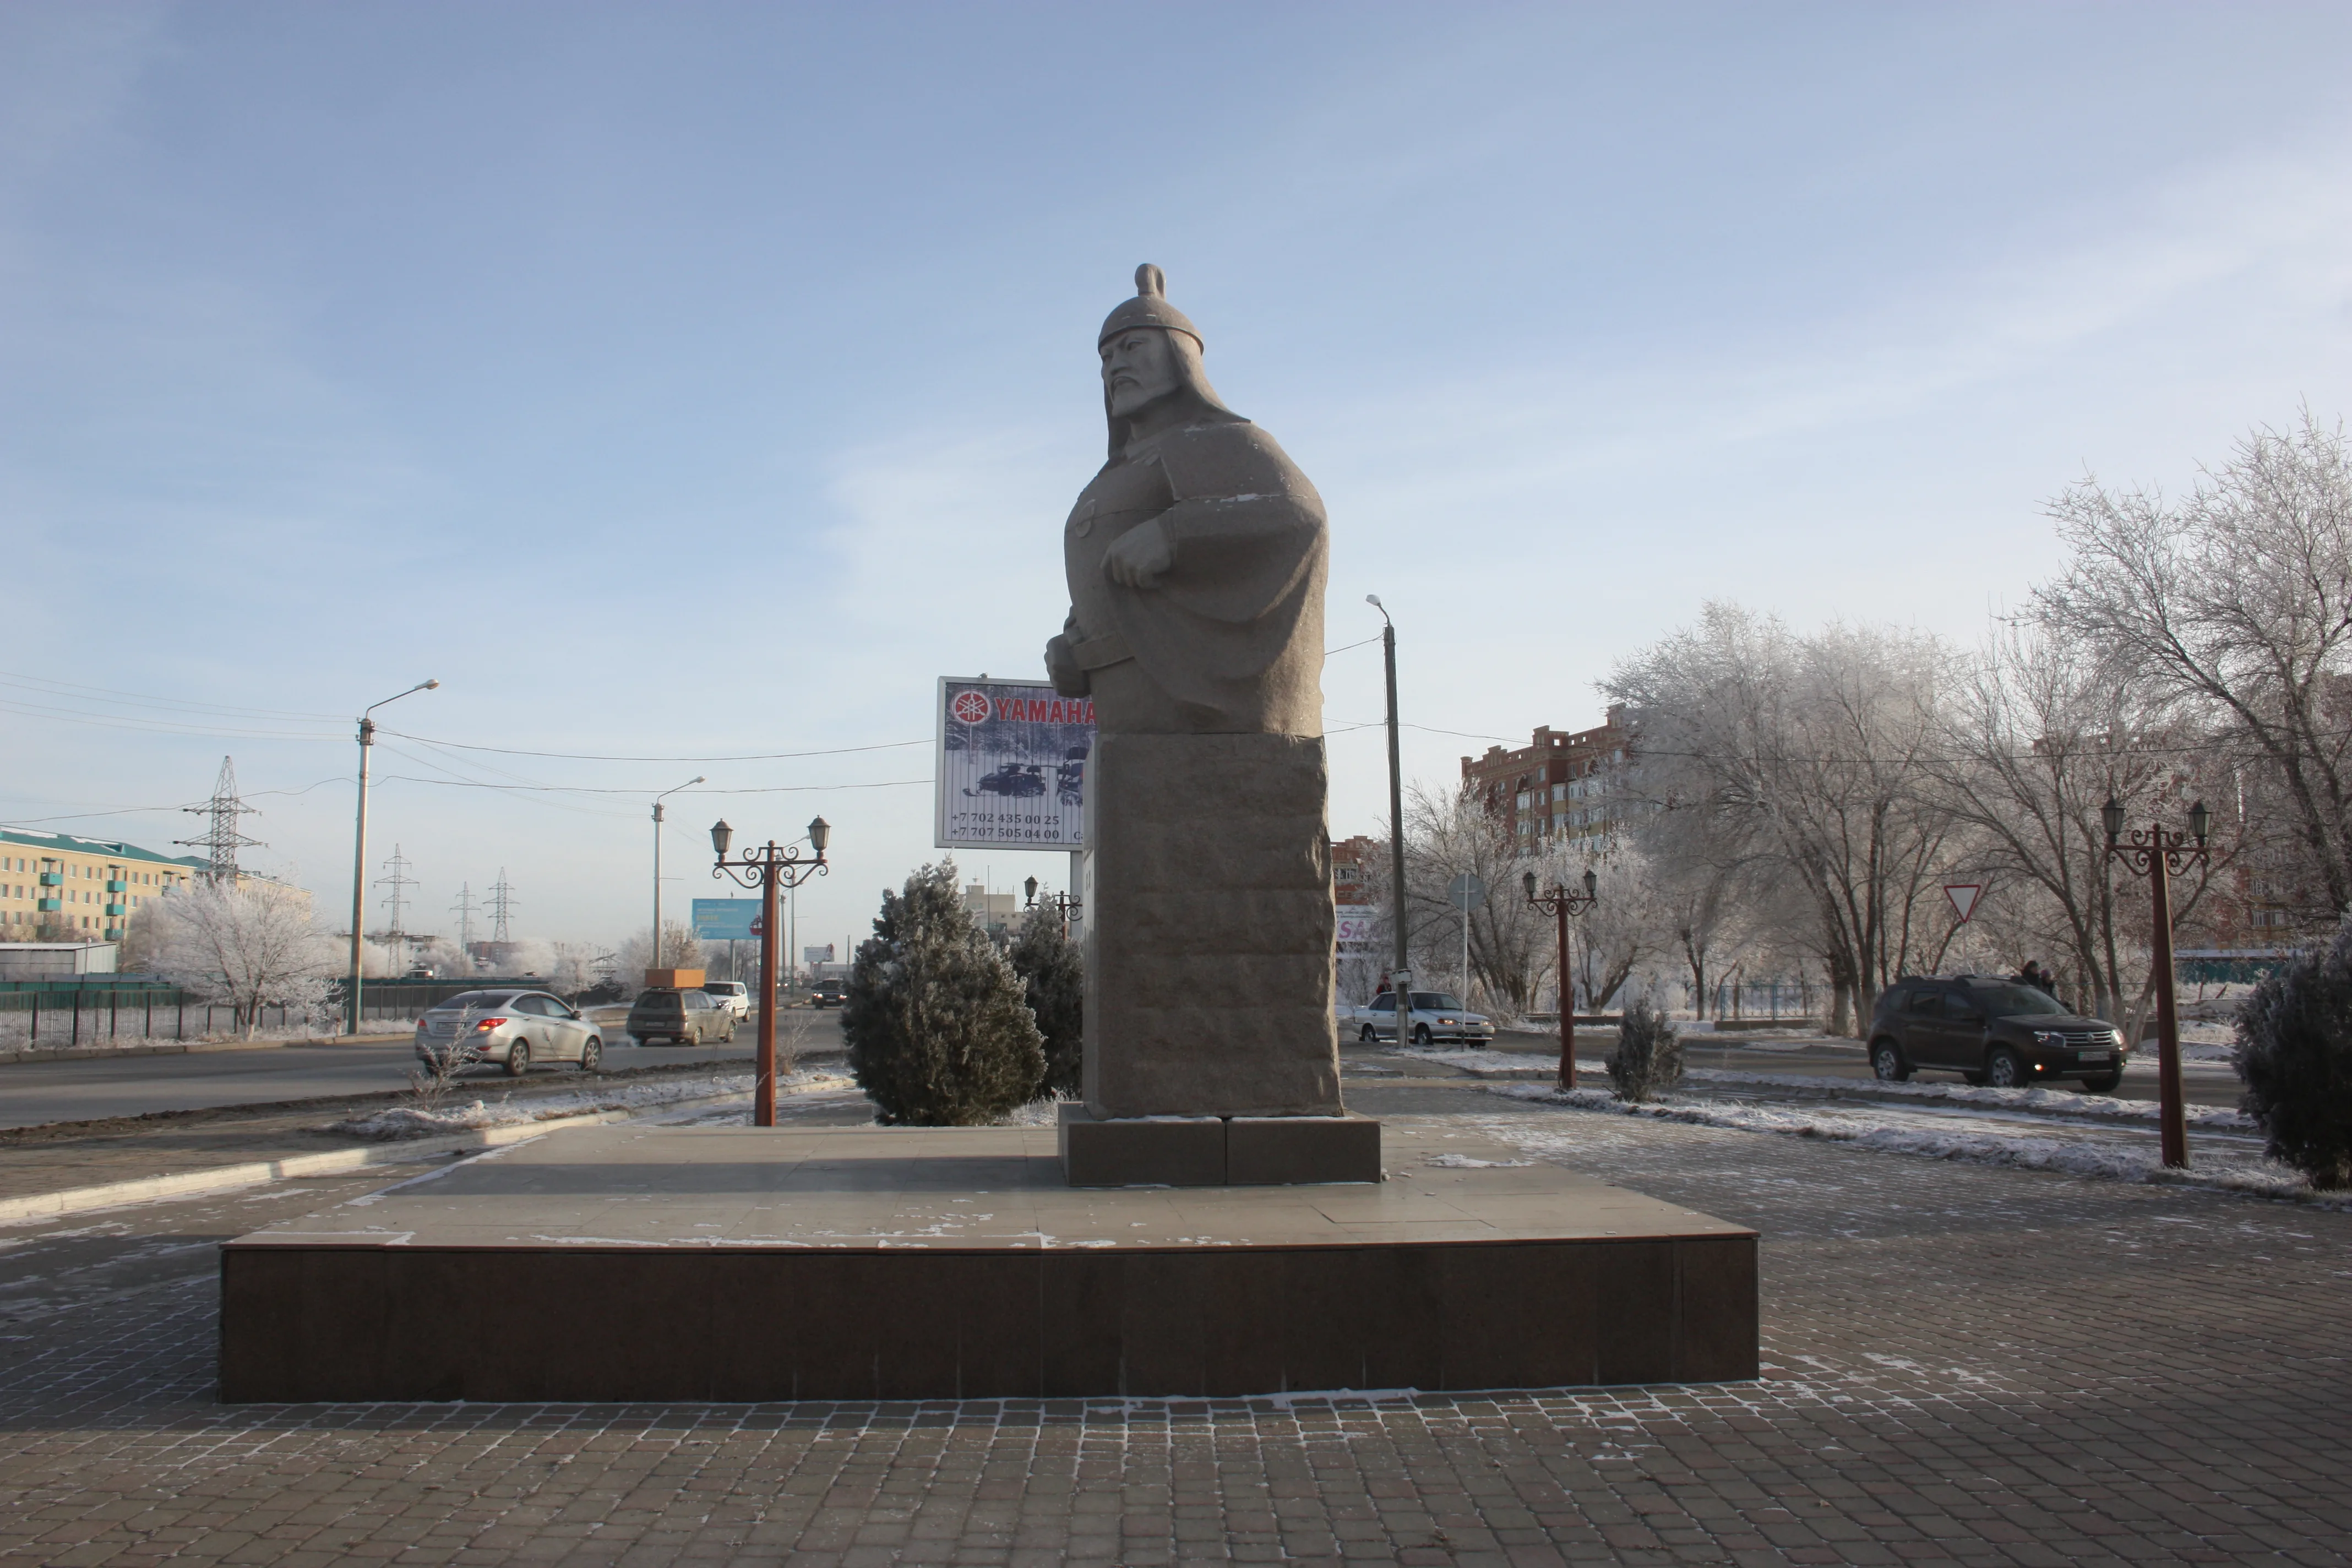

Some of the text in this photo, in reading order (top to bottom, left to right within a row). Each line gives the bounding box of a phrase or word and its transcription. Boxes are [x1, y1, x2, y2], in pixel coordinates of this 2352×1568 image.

[994, 698, 1096, 725] YAMAHA
[952, 813, 1059, 825] +7 702 435 00 25
[952, 827, 1059, 839] +7 707 505 04 00
